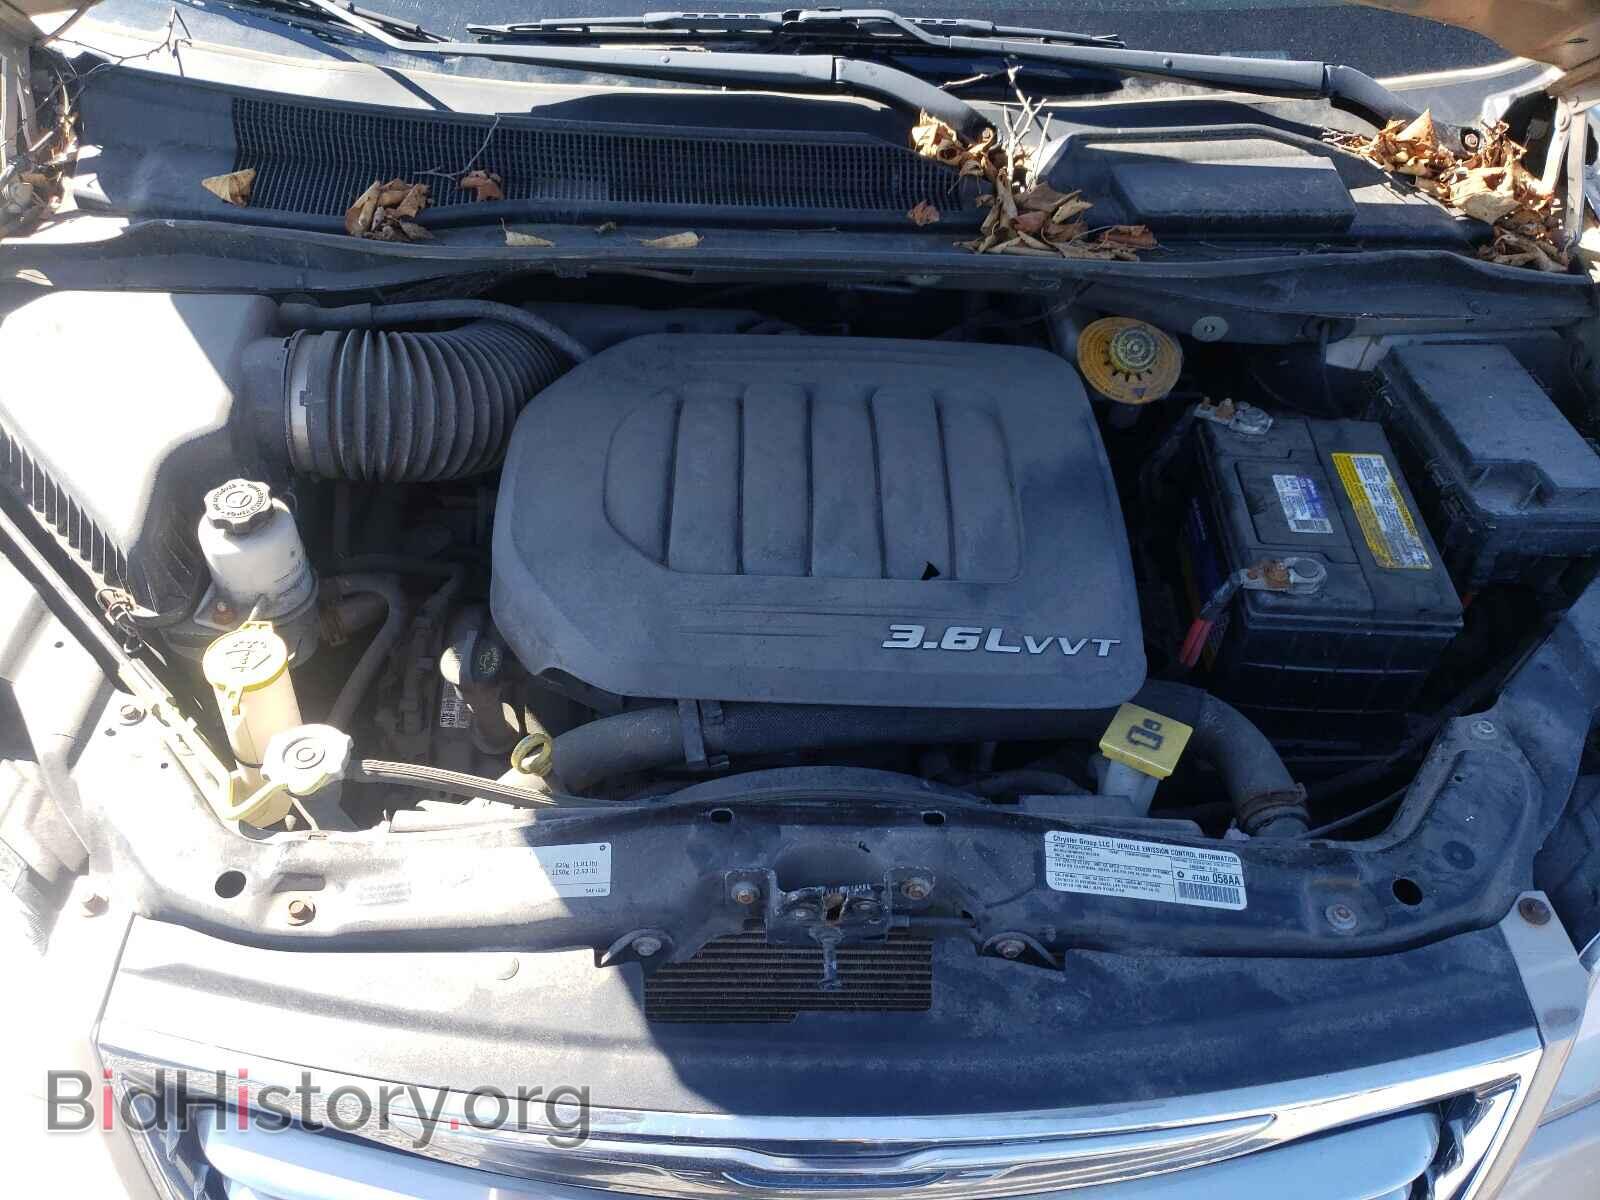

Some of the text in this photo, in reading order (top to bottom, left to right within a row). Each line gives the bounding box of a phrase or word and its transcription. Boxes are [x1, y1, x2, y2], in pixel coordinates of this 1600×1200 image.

[1053, 835, 1078, 844] Chrysler
[1099, 840, 1111, 848] LLC
[1116, 842, 1140, 851] VEHICLE
[1141, 845, 1169, 855] EMISSION
[1171, 849, 1197, 859] CONTROL
[1198, 852, 1238, 863] INFORMATION
[1212, 873, 1241, 886] 058AA
